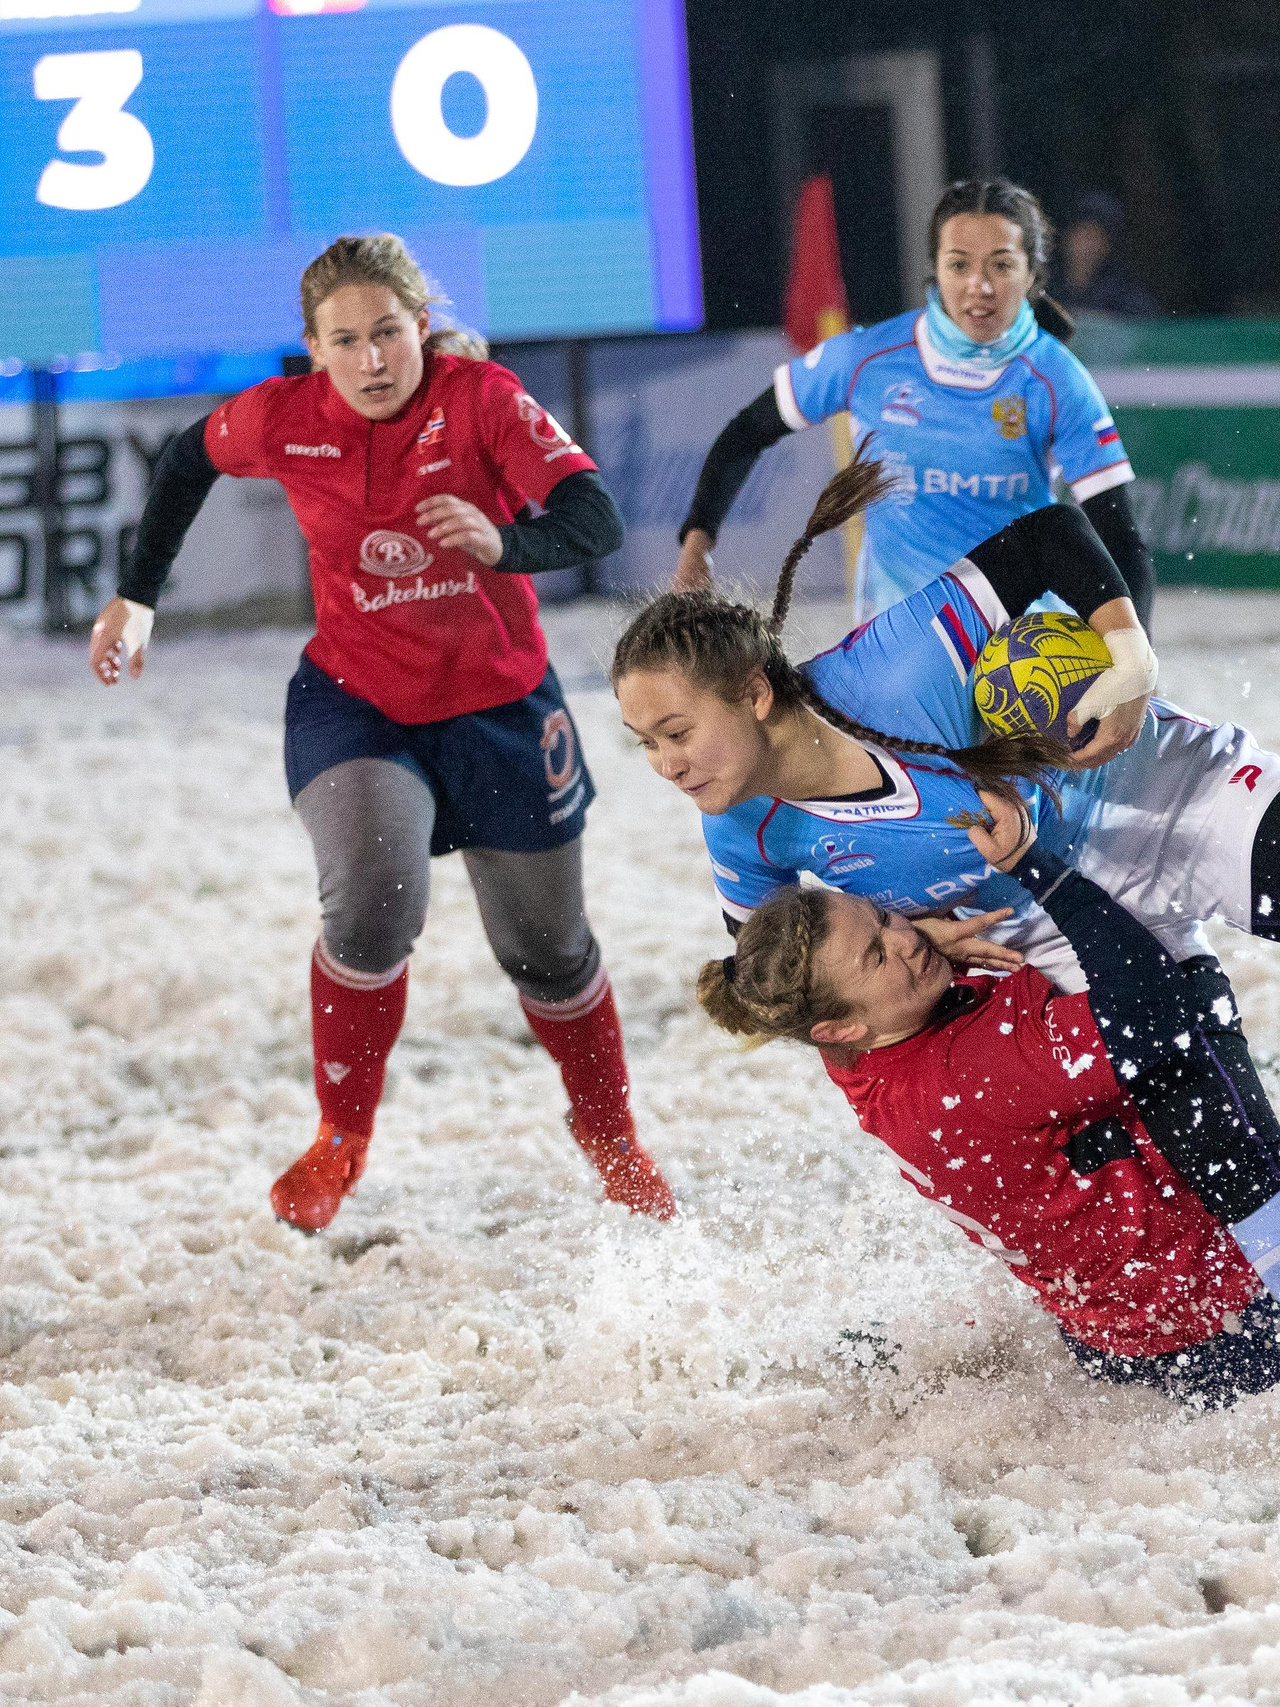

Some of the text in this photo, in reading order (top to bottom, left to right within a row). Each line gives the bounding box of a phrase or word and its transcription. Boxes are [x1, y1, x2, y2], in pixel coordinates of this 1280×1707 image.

[33, 48, 155, 211] 3
[390, 22, 539, 187] 0
[832, 857, 875, 875] Russia
